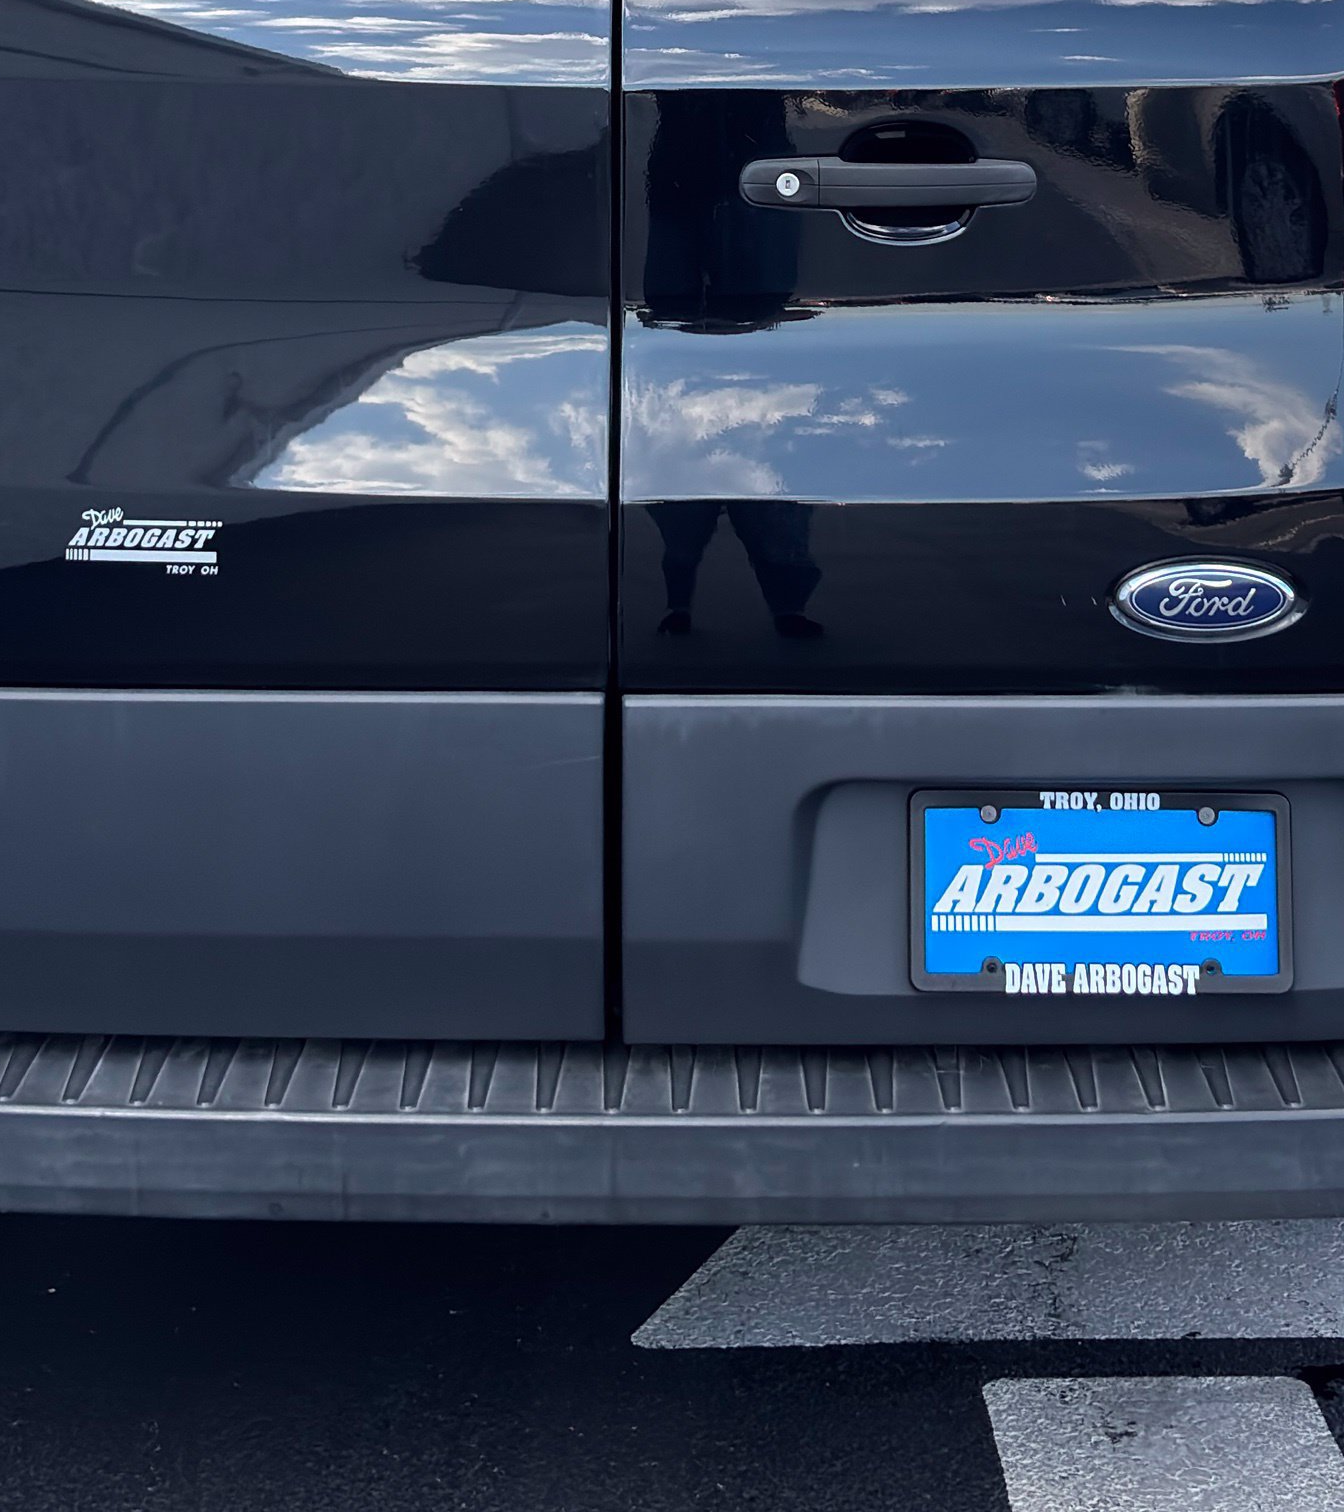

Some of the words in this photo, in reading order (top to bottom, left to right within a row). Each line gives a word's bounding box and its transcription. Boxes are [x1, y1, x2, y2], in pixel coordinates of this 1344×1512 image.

[81, 506, 124, 530] Dave
[67, 527, 216, 549] ARBOGAST
[165, 564, 195, 575] TROY
[200, 565, 219, 575] OH
[1158, 578, 1257, 617] Ford
[1039, 791, 1102, 812] TROY,
[1109, 792, 1161, 811] OHIO
[968, 831, 1039, 869] Dave
[932, 864, 1265, 914] ARBOGAST
[1241, 930, 1267, 941] OH
[1004, 962, 1067, 995] DAVE
[1072, 963, 1201, 995] ARBOGAST
